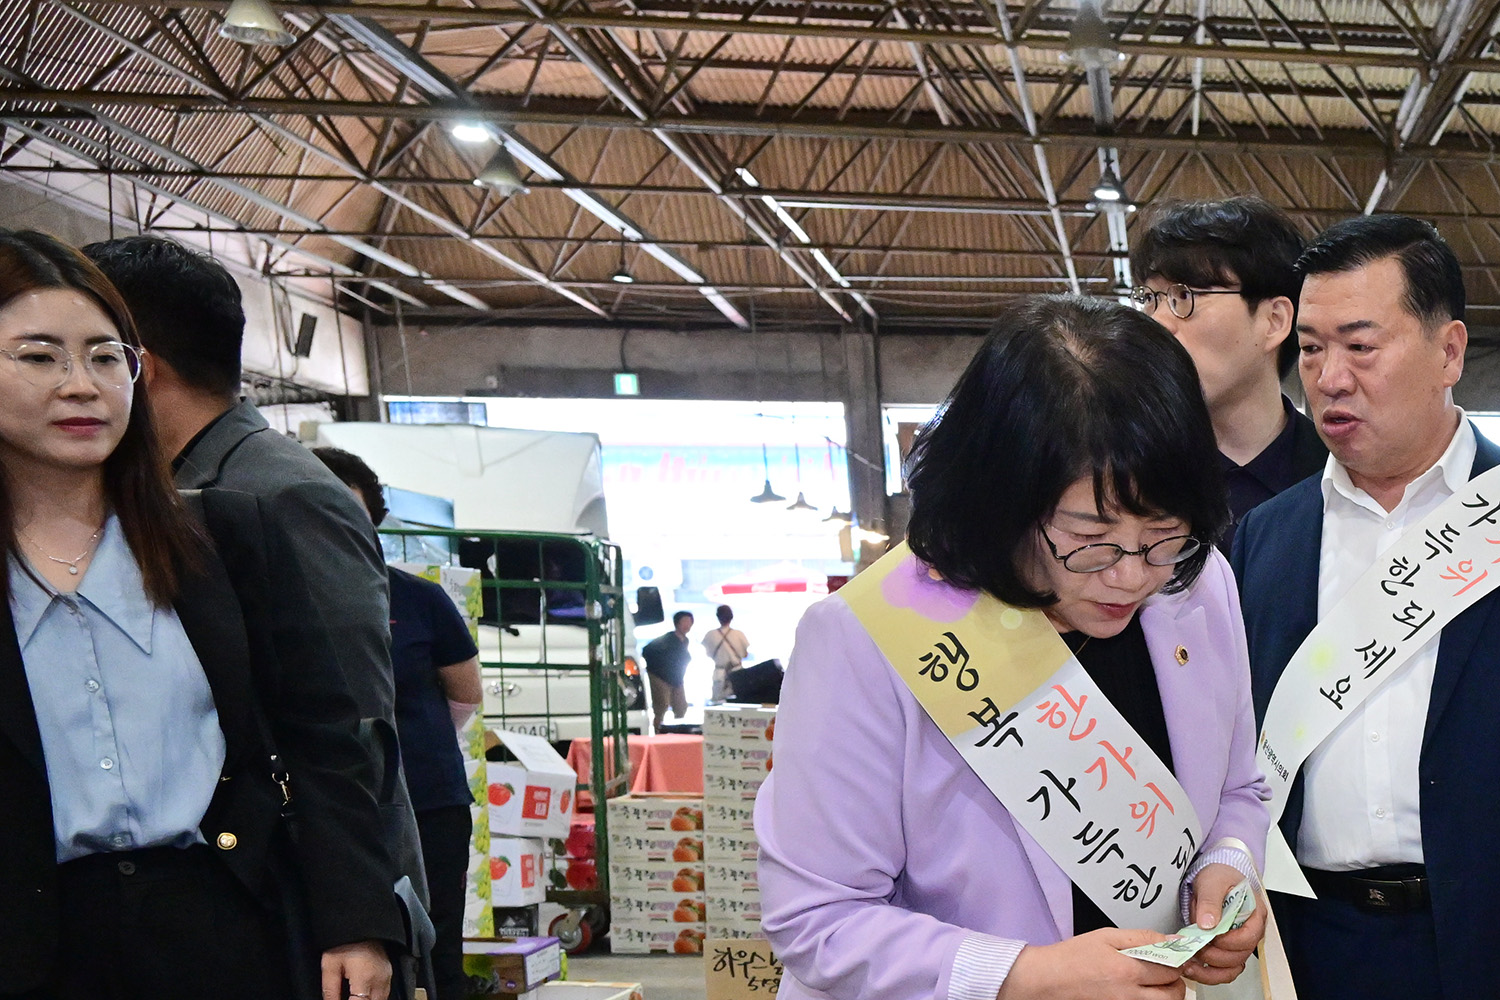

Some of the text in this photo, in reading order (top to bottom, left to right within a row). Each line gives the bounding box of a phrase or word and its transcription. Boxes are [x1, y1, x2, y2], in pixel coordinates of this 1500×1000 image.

[1319, 599, 1437, 712] 되세요
[917, 631, 1165, 910] 행복 가득한
[1034, 684, 1175, 838] 한가위
